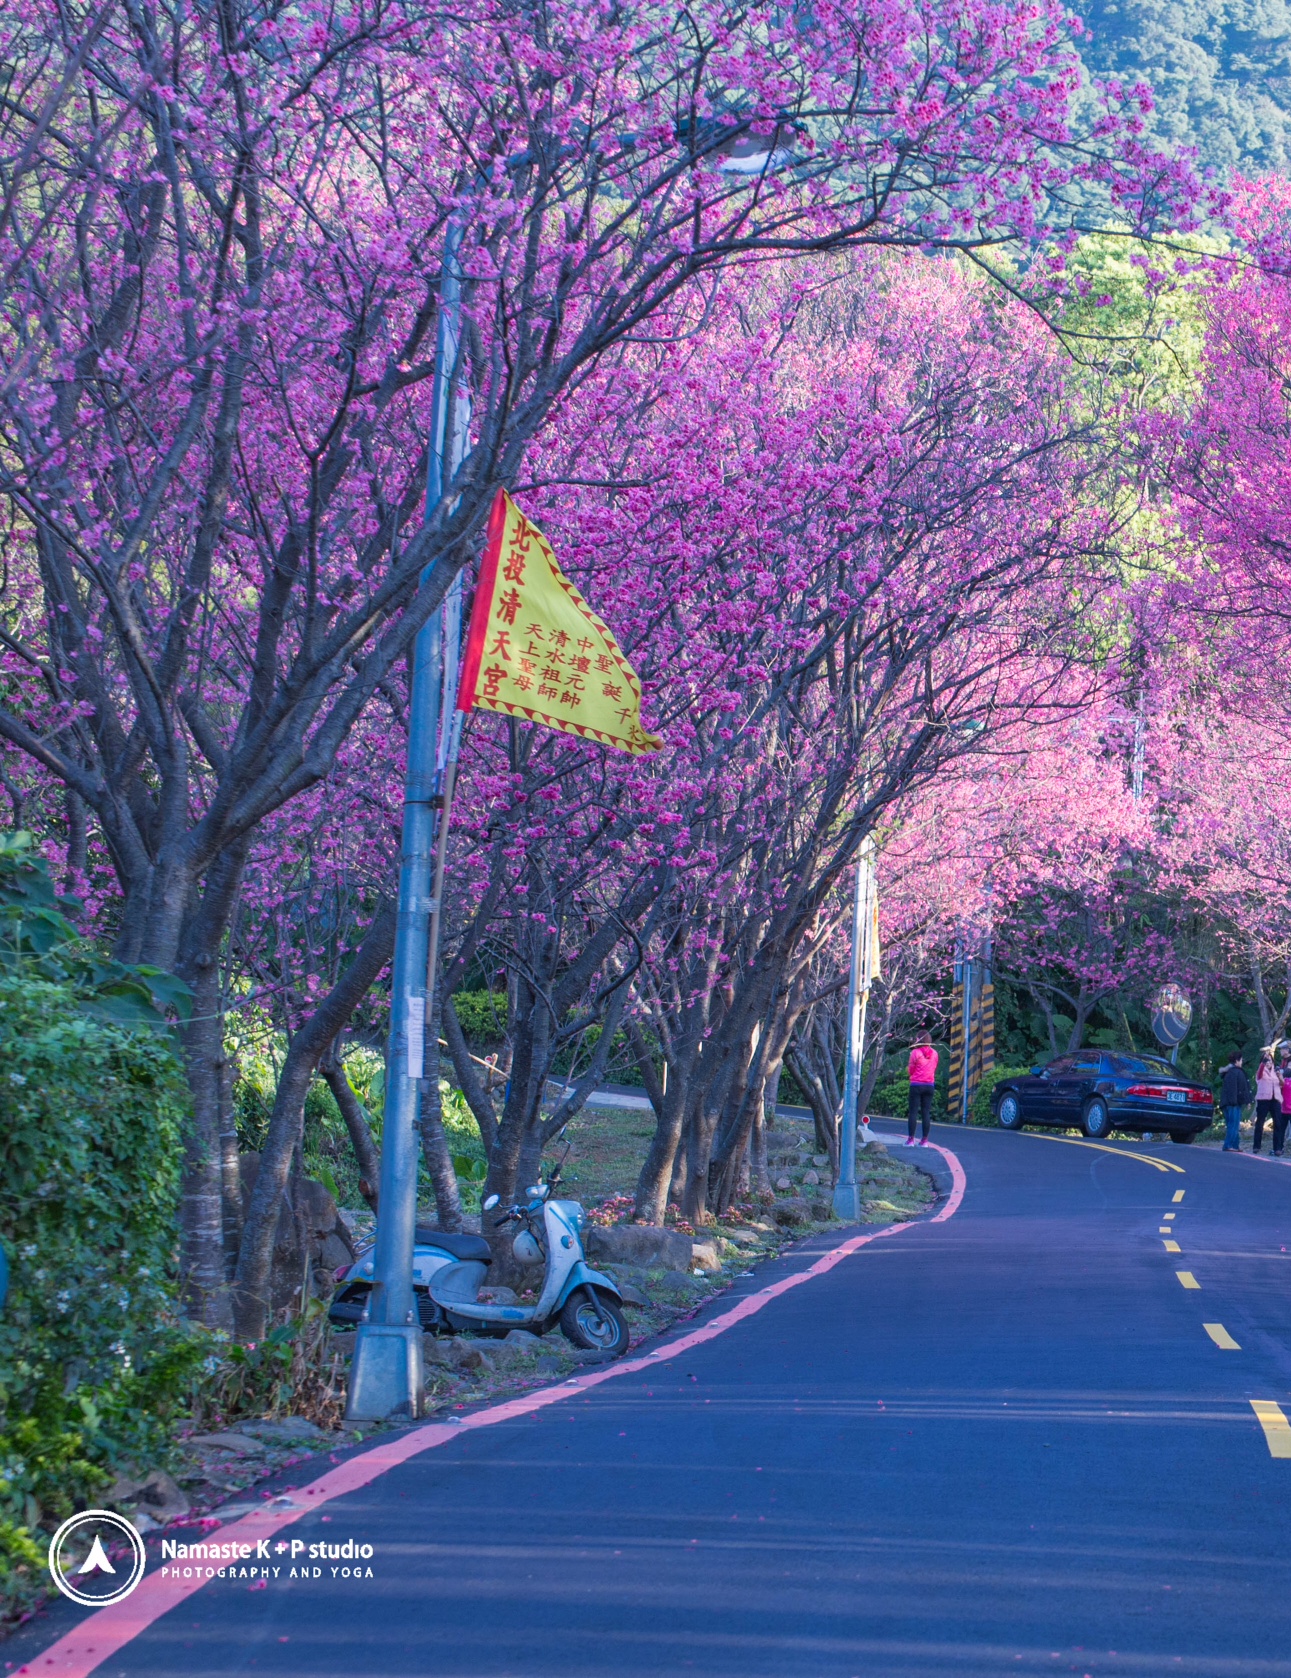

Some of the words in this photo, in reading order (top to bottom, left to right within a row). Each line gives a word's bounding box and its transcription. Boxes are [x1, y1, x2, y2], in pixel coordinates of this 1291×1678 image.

[483, 519, 531, 698] 北投清天宮
[512, 622, 545, 692] 天上聖母
[537, 628, 572, 702] 清水祖師
[559, 635, 595, 710] 中壇元帥
